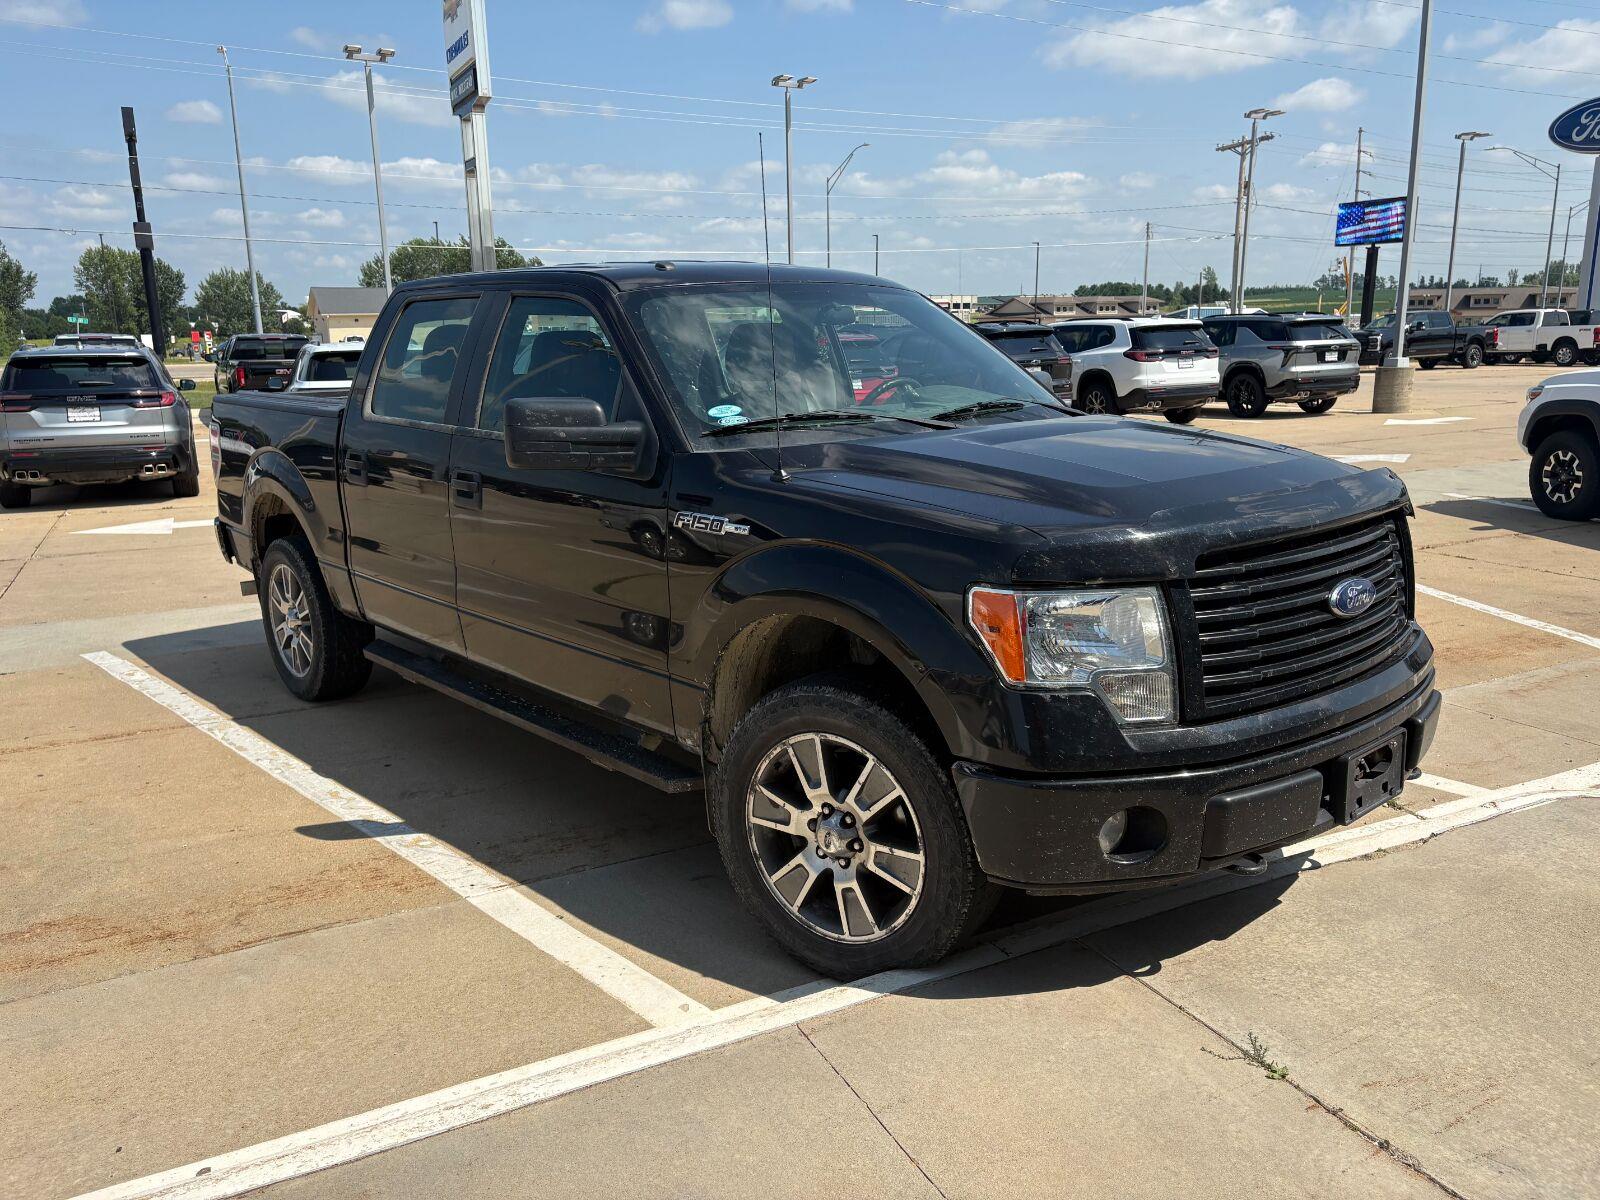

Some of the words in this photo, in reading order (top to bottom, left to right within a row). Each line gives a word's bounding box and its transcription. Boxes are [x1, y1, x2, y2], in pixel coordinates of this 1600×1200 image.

[223, 427, 247, 442] STX
[673, 510, 729, 536] F-150
[1346, 584, 1371, 609] Ford
